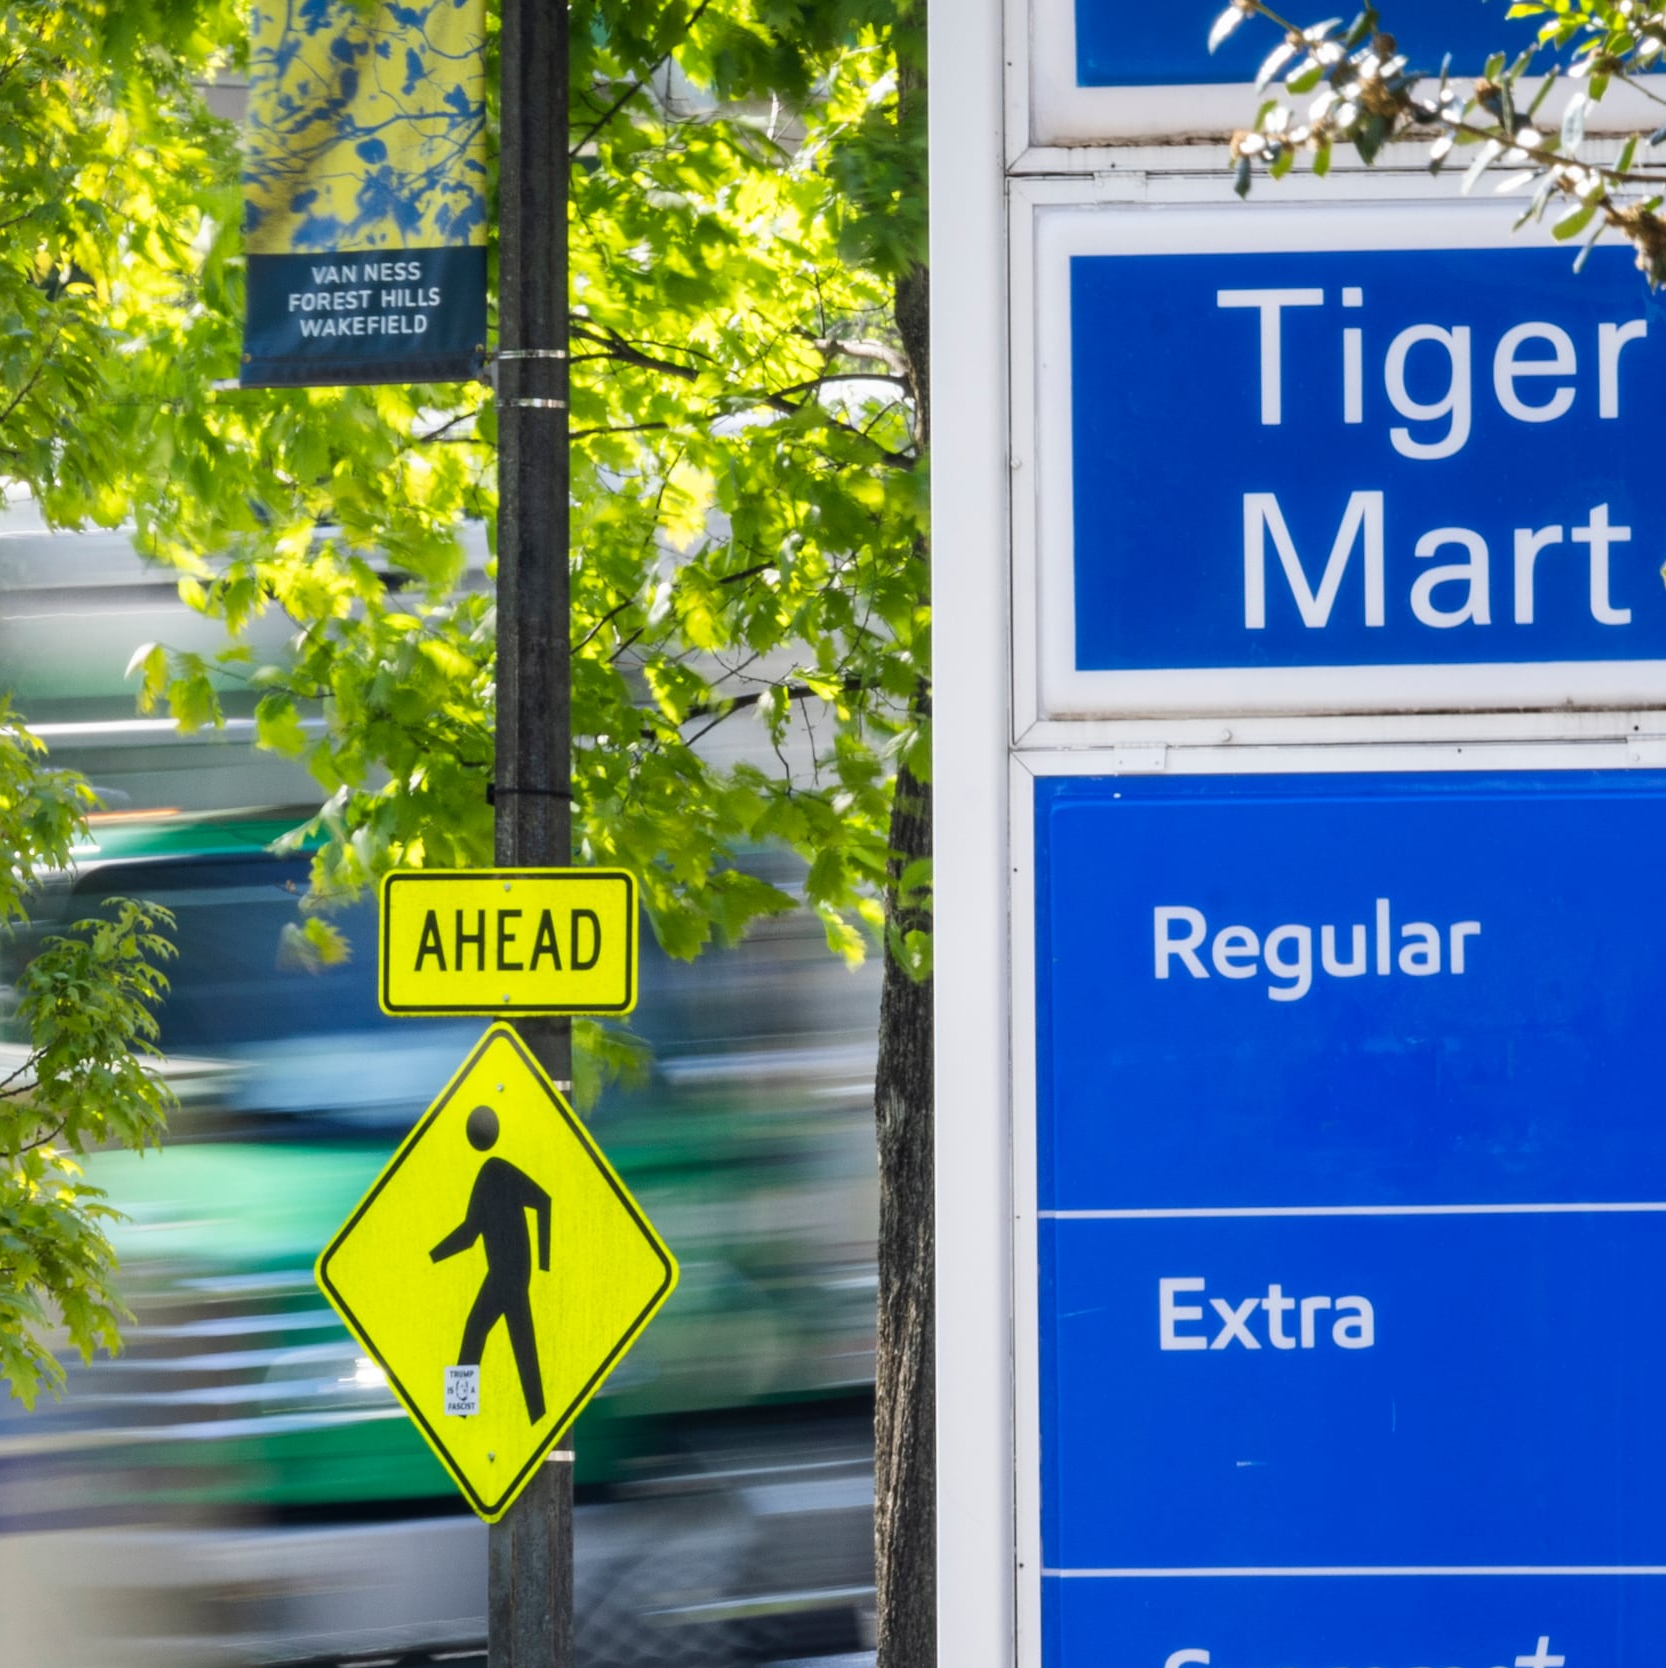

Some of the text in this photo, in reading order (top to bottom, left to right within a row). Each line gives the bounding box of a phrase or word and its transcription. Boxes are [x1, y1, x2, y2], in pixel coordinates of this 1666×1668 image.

[311, 261, 422, 285] VAN NESS
[288, 287, 441, 312] FOREST HILLS
[299, 315, 428, 337] WAKEFIELD
[1215, 287, 1649, 460] Tiger
[1243, 490, 1632, 630] Mart
[414, 908, 602, 972] AHEAD
[1153, 898, 1482, 1002] Regular
[1159, 1277, 1375, 1351] Extra
[450, 1370, 474, 1378] TRUMP
[448, 1402, 475, 1410] FASCIST
